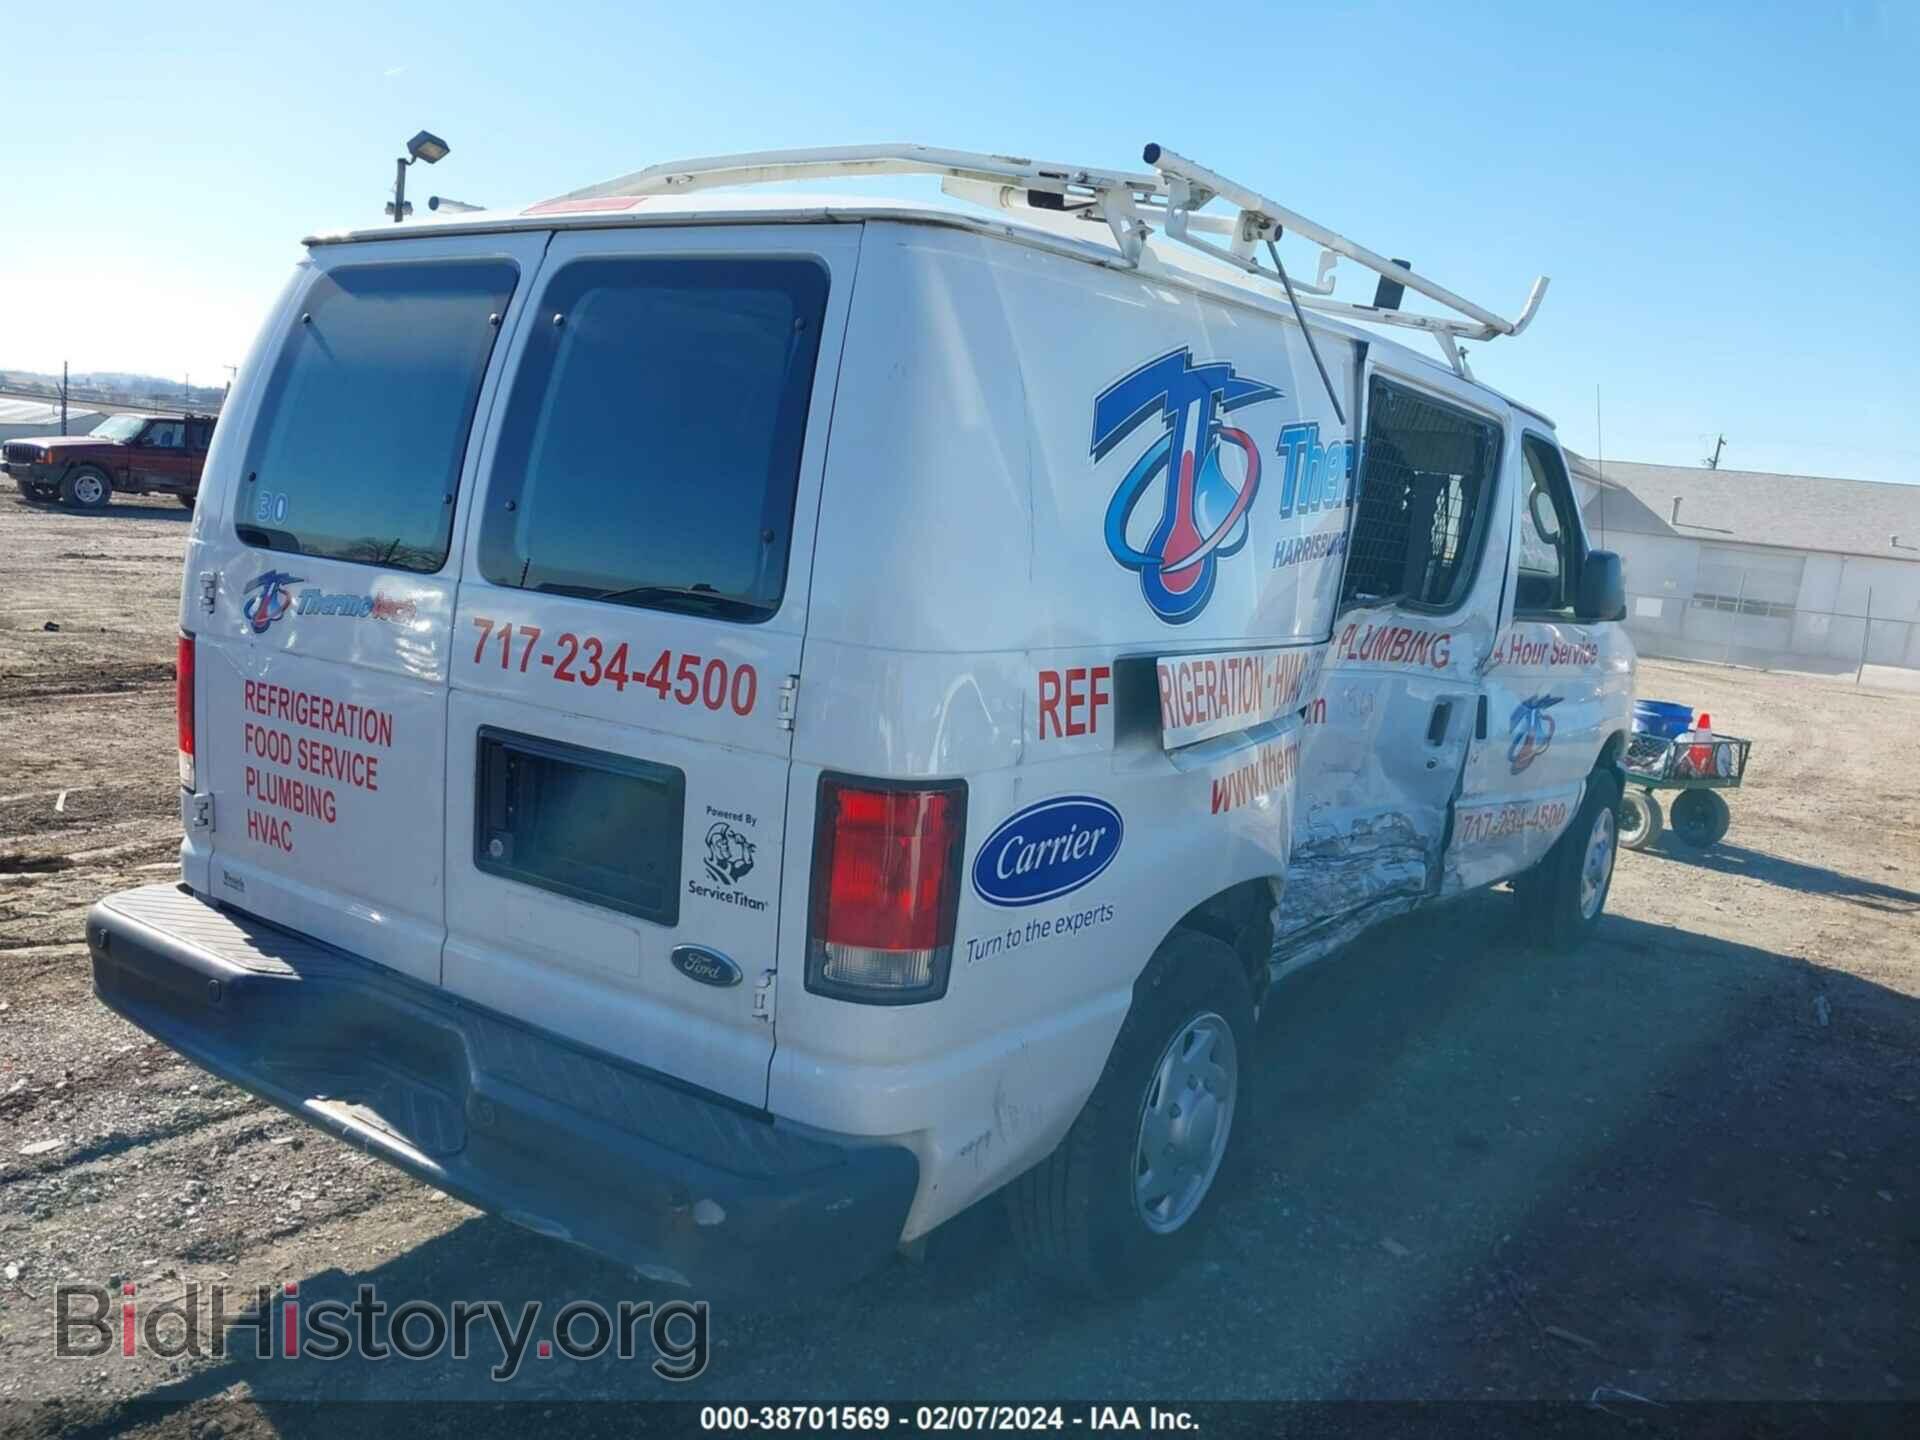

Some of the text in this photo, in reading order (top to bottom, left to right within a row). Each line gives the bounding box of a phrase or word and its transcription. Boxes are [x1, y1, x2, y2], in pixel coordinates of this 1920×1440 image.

[256, 489, 288, 526] 30
[472, 616, 758, 717] 717-234-4500
[1337, 622, 1451, 669] PLUMBING
[1509, 633, 1549, 665] Hour
[1550, 635, 1599, 666] Service
[244, 679, 393, 748] REFRIGERATION
[1038, 666, 1111, 741] REF
[1157, 656, 1264, 729] RIGERATION
[244, 723, 378, 791] FOOD SERVICE
[246, 766, 337, 824] PLUMBING
[706, 805, 758, 828] Powered By
[247, 808, 293, 852] HVAC
[996, 823, 1107, 880] Carrier
[688, 879, 766, 912] ServiceTitan
[967, 903, 1114, 963] Turn to the experts
[683, 952, 721, 980] Ford
